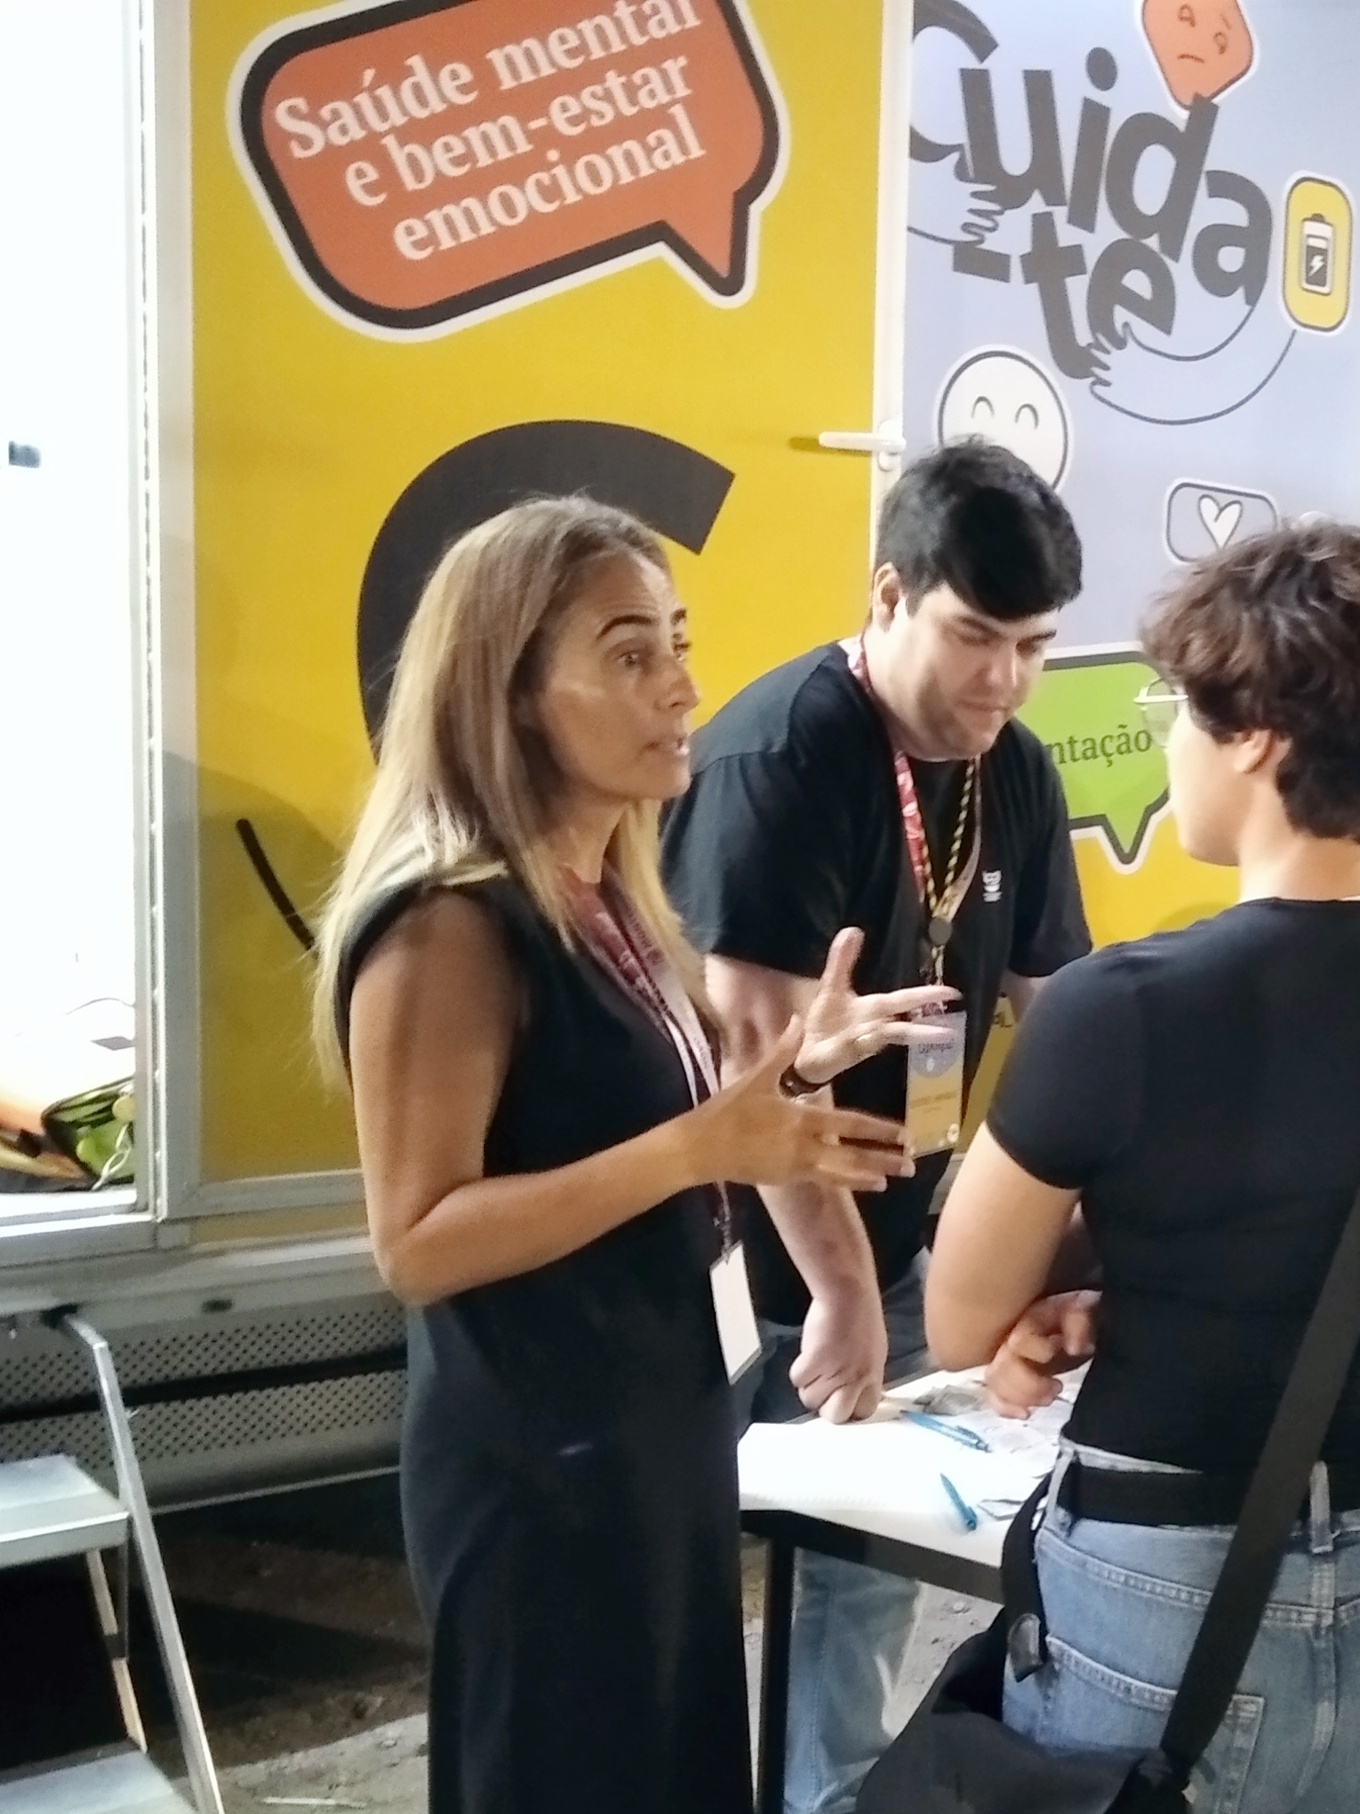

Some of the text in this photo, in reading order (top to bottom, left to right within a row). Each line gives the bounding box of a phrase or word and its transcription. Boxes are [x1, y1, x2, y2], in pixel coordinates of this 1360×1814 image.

[275, 54, 479, 159] Saúde
[344, 55, 693, 207] e bem-estar
[393, 103, 706, 262] emocional
[1045, 724, 1153, 768] ntação
